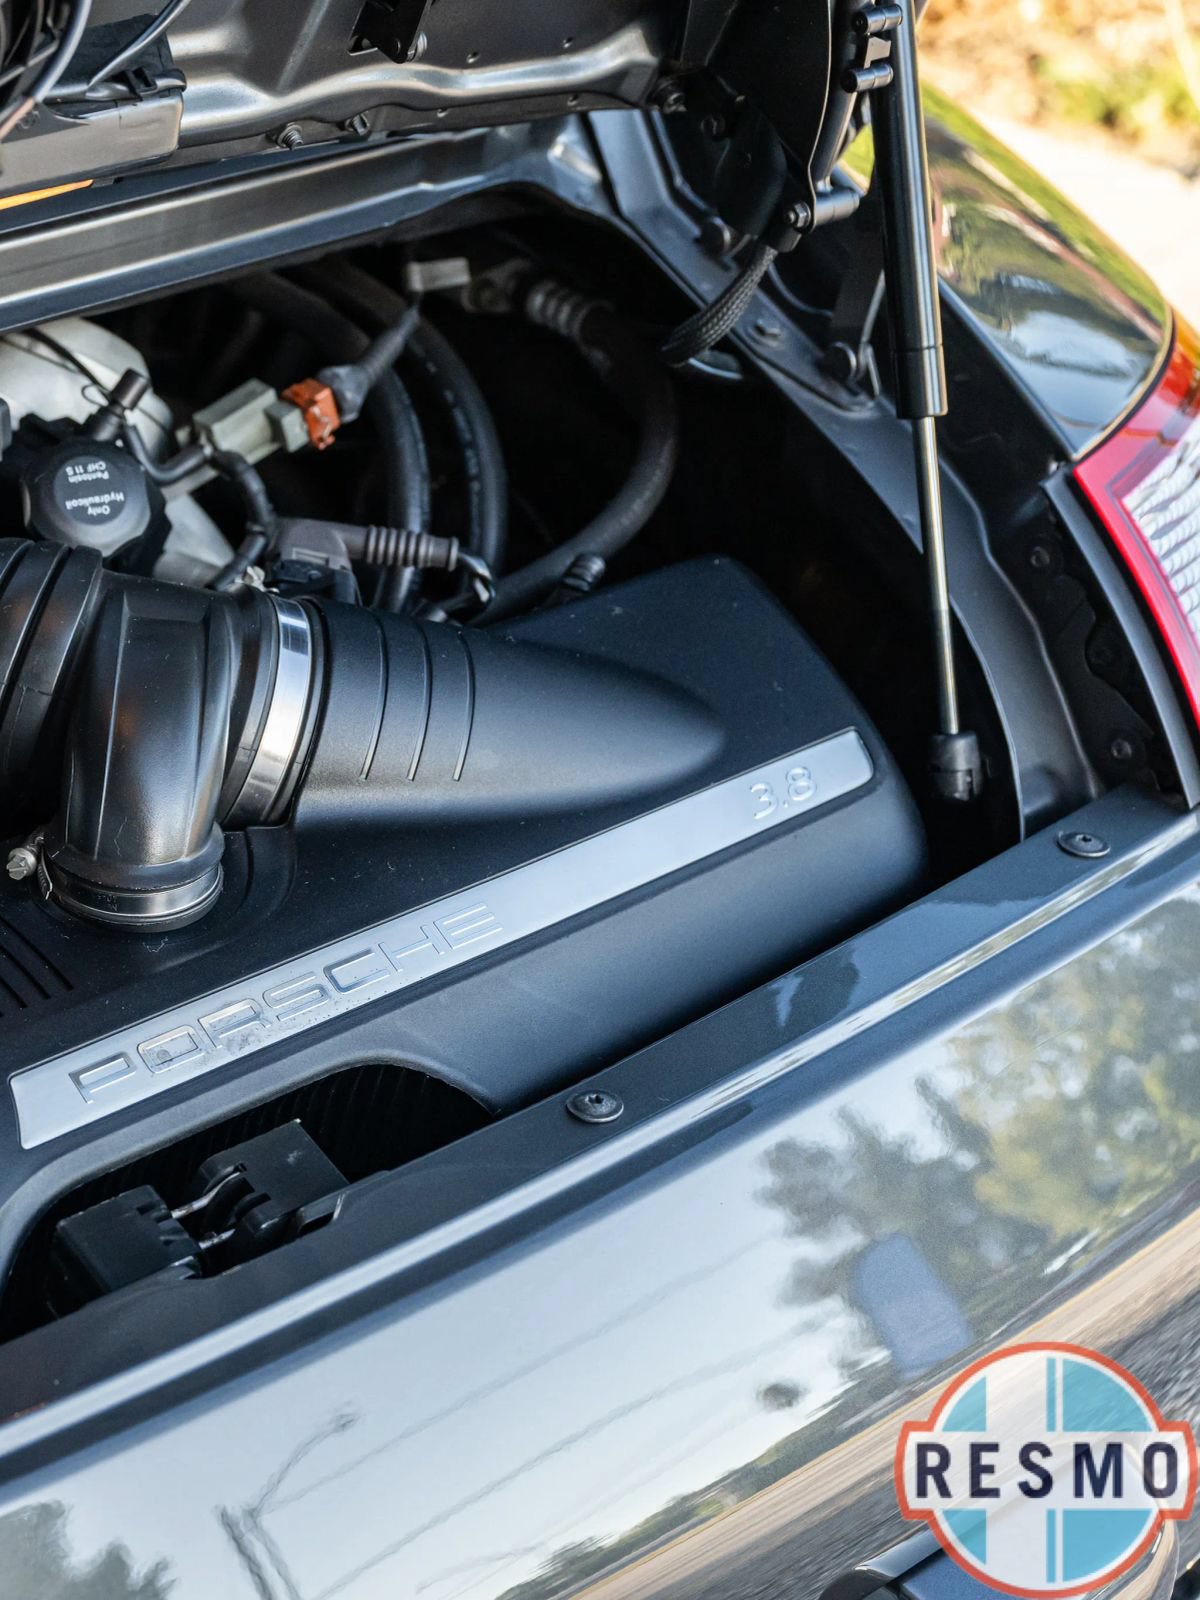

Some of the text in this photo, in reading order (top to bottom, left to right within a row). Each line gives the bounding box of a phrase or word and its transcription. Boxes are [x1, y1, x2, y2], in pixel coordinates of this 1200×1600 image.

[87, 461, 106, 473] CHF
[68, 470, 109, 484] Pentosin
[87, 504, 110, 516] Only
[749, 766, 818, 819] 3.8
[68, 902, 502, 1104] PORSCHE
